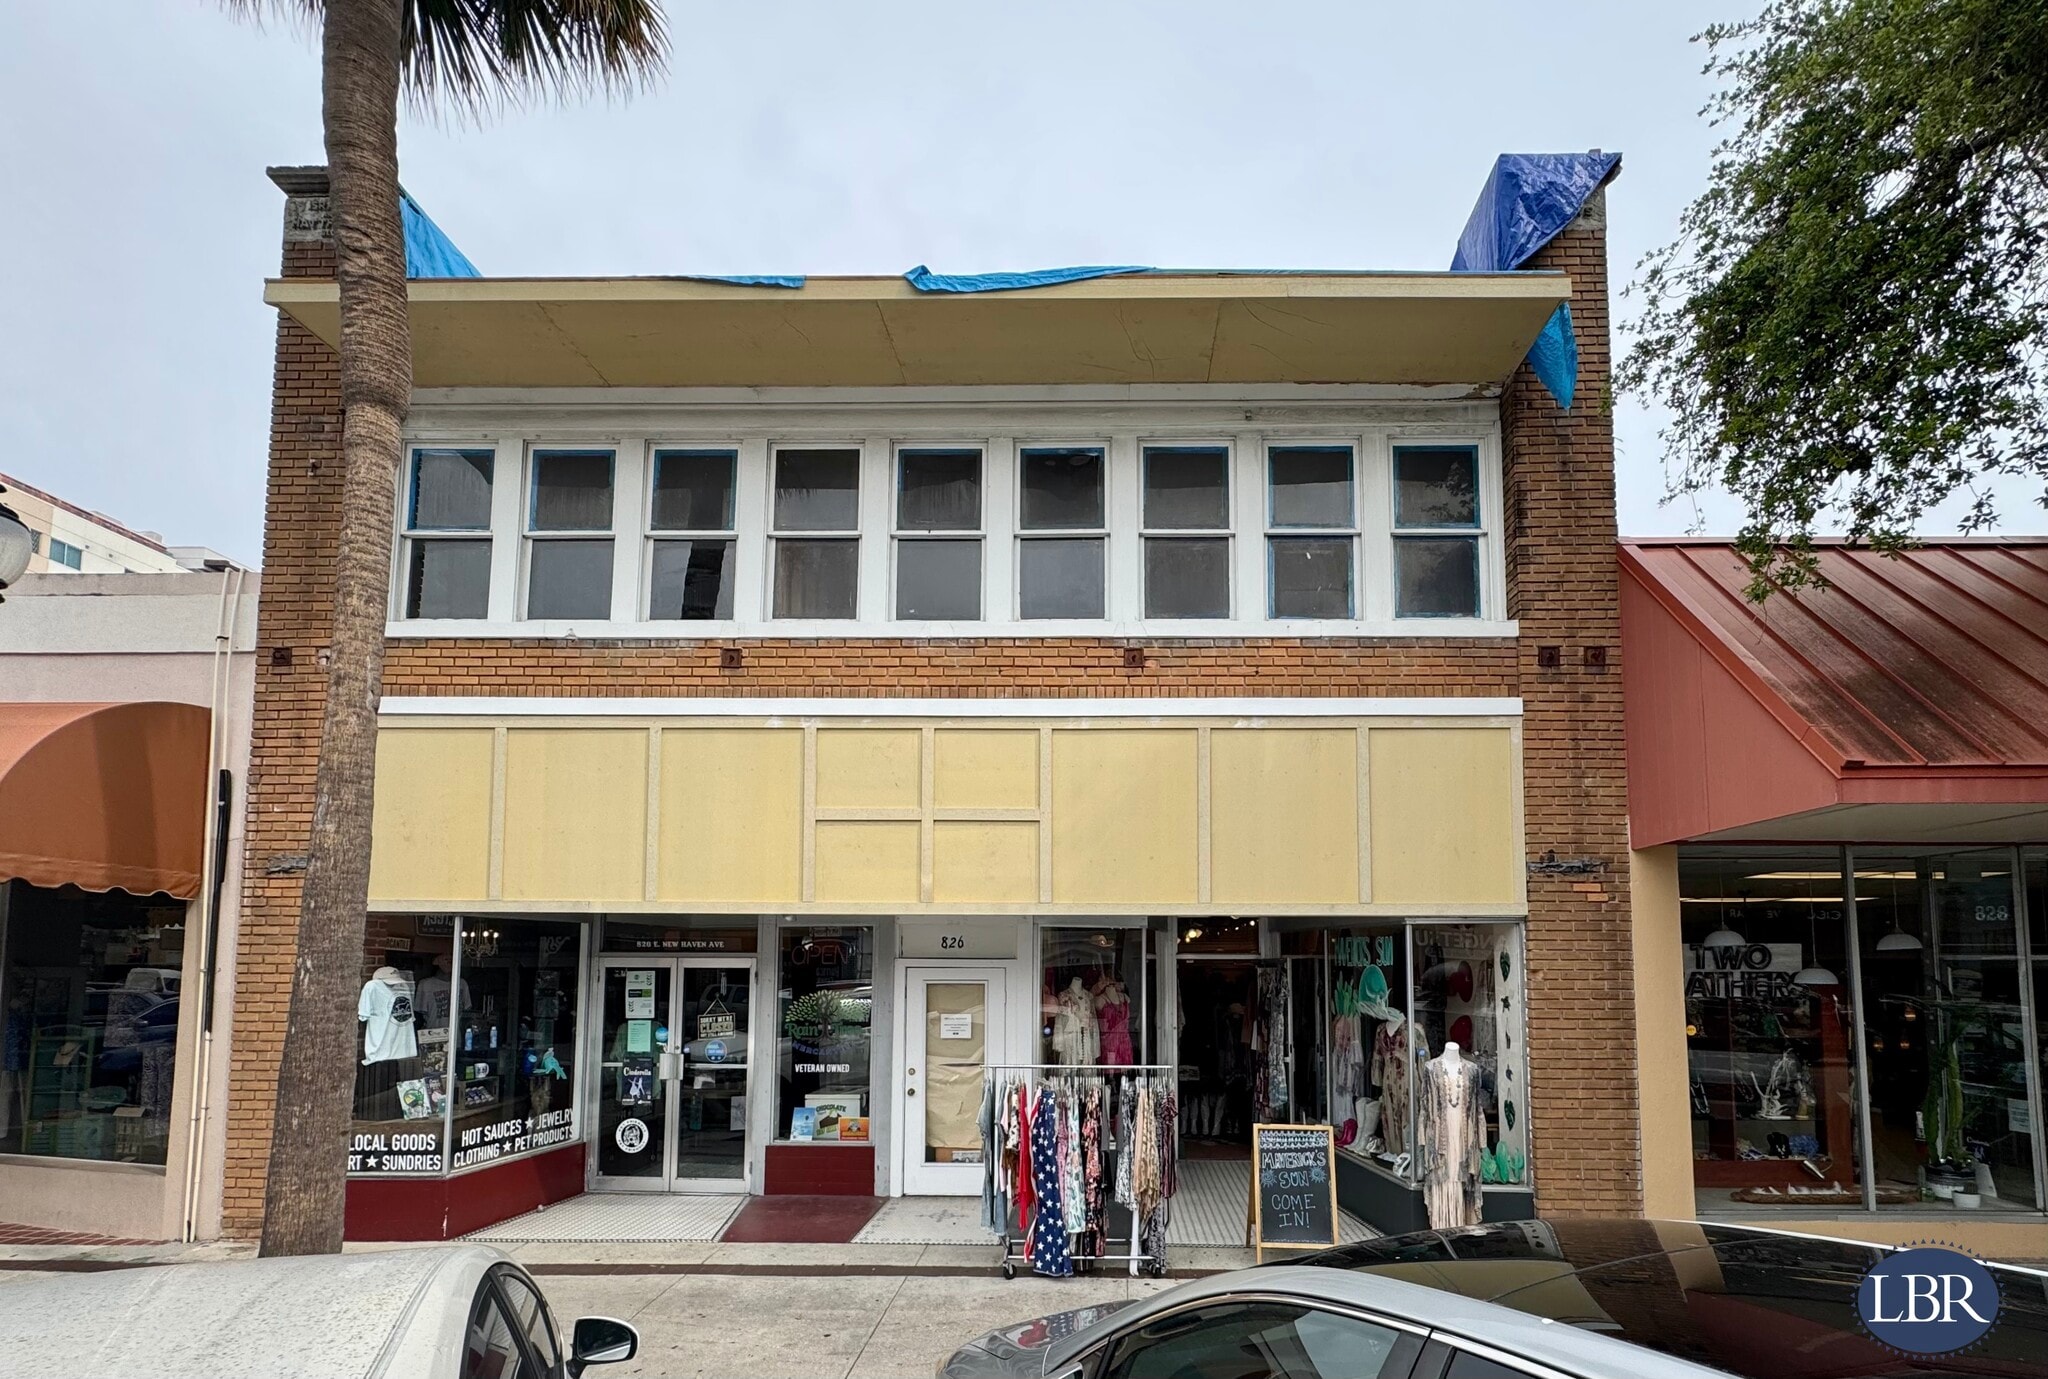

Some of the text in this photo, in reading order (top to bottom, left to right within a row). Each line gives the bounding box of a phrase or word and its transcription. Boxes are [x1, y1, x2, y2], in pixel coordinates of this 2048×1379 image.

[662, 940, 679, 948] NEW
[680, 940, 707, 948] HAVEN
[708, 940, 725, 948] AVE
[940, 935, 965, 949] 826
[791, 945, 849, 966] OPEN
[1689, 943, 1772, 970] TWO
[784, 1022, 818, 1040] Rain
[624, 1067, 651, 1077] Cinderella
[795, 1063, 850, 1073] VETERAN OWNED
[815, 1104, 847, 1113] CHOCOLATE
[461, 1107, 574, 1147] HOT SAUCES JEWELRY
[391, 1133, 436, 1151] GOODS
[453, 1125, 574, 1168] CLOTHING PET PRODUCTS
[381, 1154, 442, 1171] SUNDRIES
[1261, 1149, 1327, 1169] MAVERICK'S
[1278, 1170, 1310, 1189] SUN
[1271, 1193, 1316, 1210] COME
[1278, 1211, 1310, 1229] IN!
